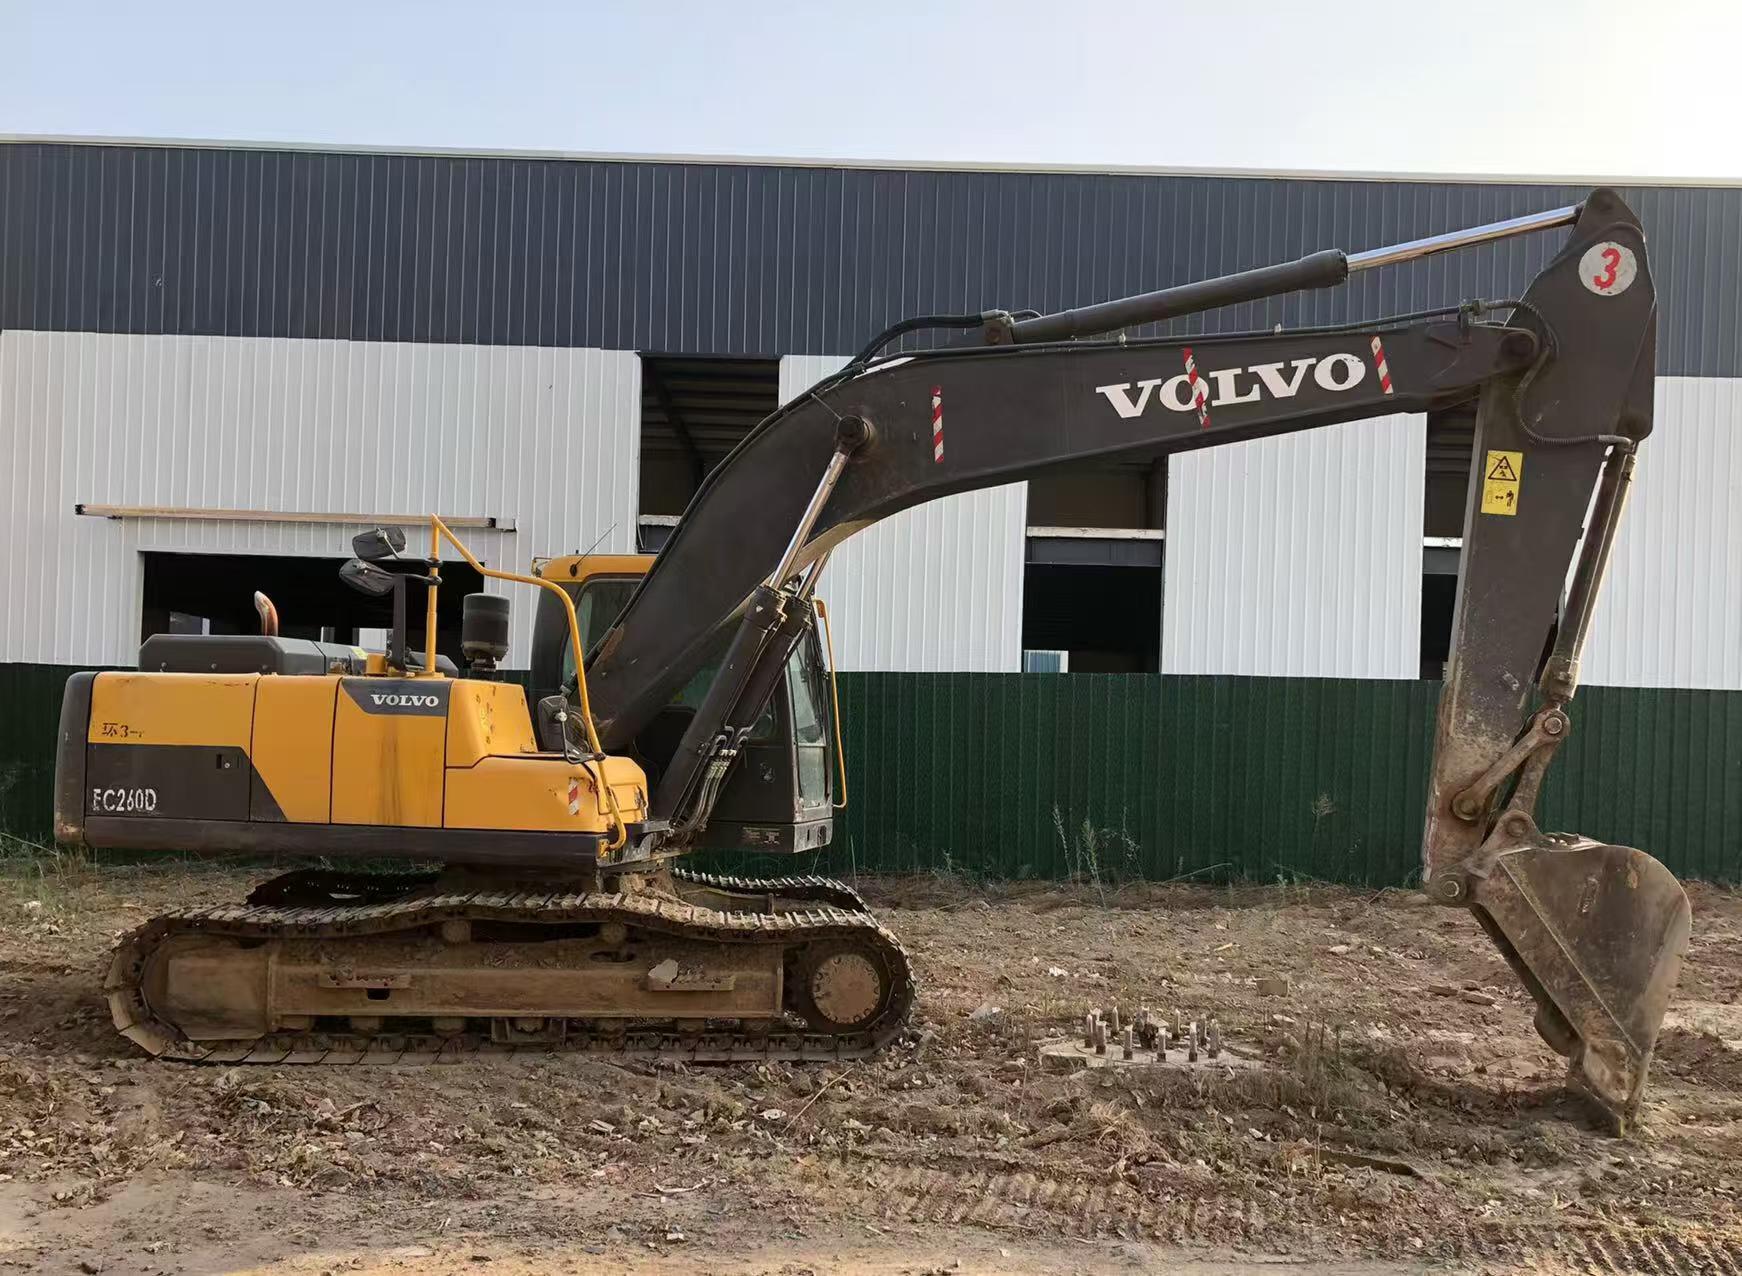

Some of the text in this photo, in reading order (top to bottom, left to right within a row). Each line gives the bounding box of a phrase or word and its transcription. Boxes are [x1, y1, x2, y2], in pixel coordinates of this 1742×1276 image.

[1594, 247, 1621, 288] 3
[1096, 353, 1366, 419] VOLVO
[371, 694, 439, 707] VOLVO
